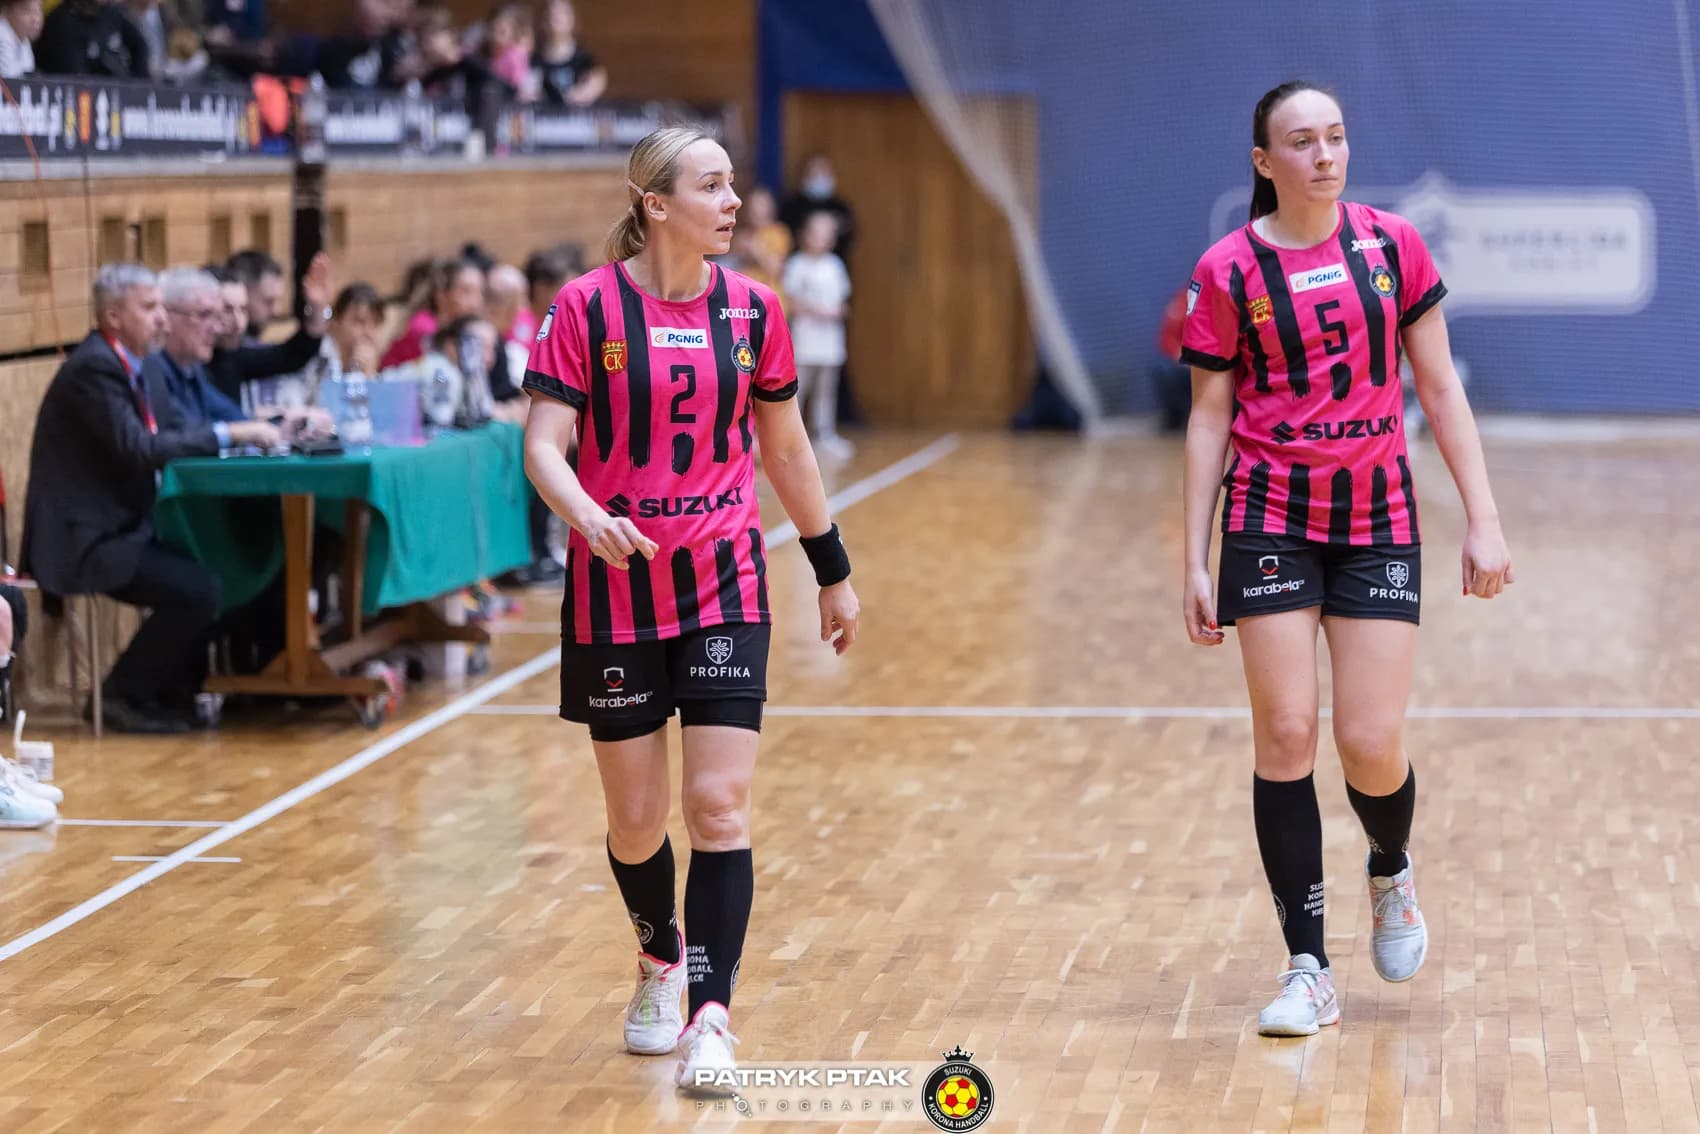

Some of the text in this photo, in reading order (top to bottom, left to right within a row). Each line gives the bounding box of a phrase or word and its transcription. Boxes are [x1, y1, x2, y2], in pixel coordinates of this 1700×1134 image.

[1307, 269, 1343, 285] PGNiG
[1314, 299, 1350, 356] 5
[667, 332, 704, 345] PGNiG
[603, 352, 624, 372] CK
[669, 364, 697, 424] 2
[1302, 415, 1398, 441] SUZUKI
[638, 486, 743, 519] SUZUKI
[1243, 579, 1300, 599] karabela
[1369, 587, 1418, 604] PROFIKA
[690, 666, 751, 678] PROFIKA
[588, 692, 647, 709] karabela
